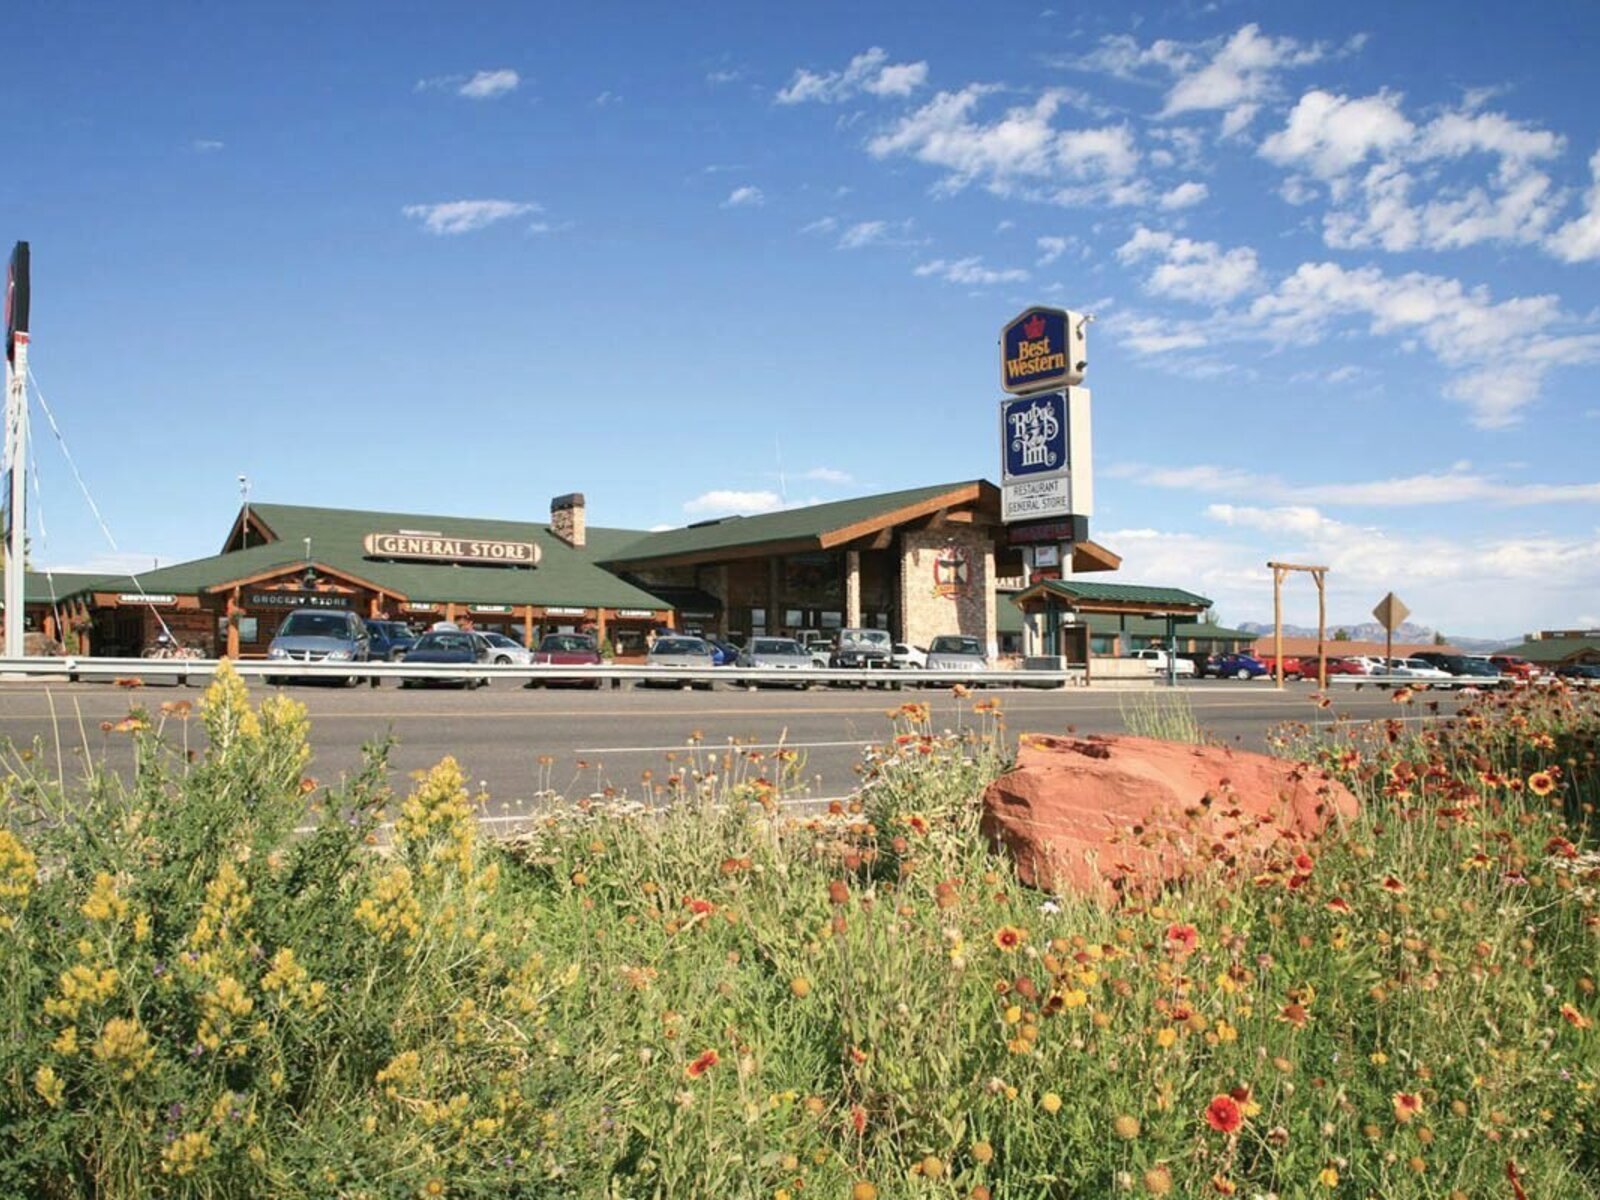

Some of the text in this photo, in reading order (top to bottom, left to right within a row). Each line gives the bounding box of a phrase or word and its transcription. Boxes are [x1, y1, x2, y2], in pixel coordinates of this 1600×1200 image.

[1018, 337, 1051, 360] Best
[1007, 353, 1065, 378] Western
[1012, 440, 1057, 466] Inn
[1013, 481, 1059, 496] RESTAURANT
[1008, 496, 1067, 513] GENERAL STORE
[384, 537, 526, 560] GENERAL STORE
[253, 595, 347, 606] GROCERY STORE
